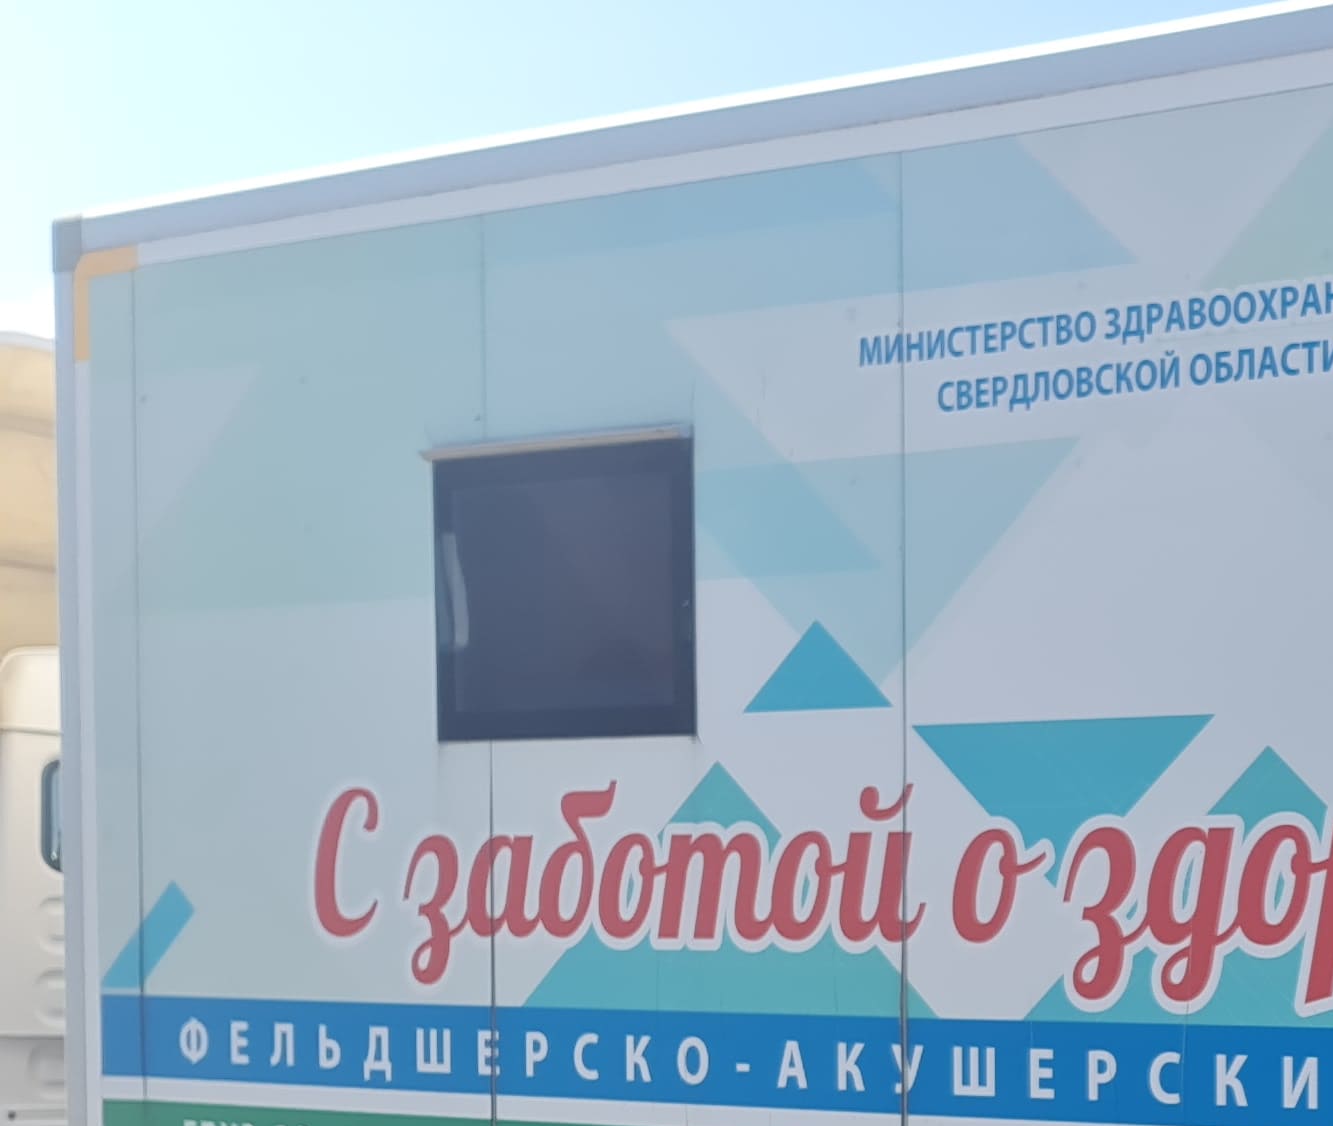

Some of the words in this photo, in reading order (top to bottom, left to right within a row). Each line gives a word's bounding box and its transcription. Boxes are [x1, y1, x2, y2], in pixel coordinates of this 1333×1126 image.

[859, 309, 1097, 367] МИНИСТЕРСТВО
[936, 348, 1180, 413] СВЕРДЛОВСКОЙ
[312, 785, 380, 939] С
[403, 779, 927, 985] заботой
[951, 827, 1047, 945] о
